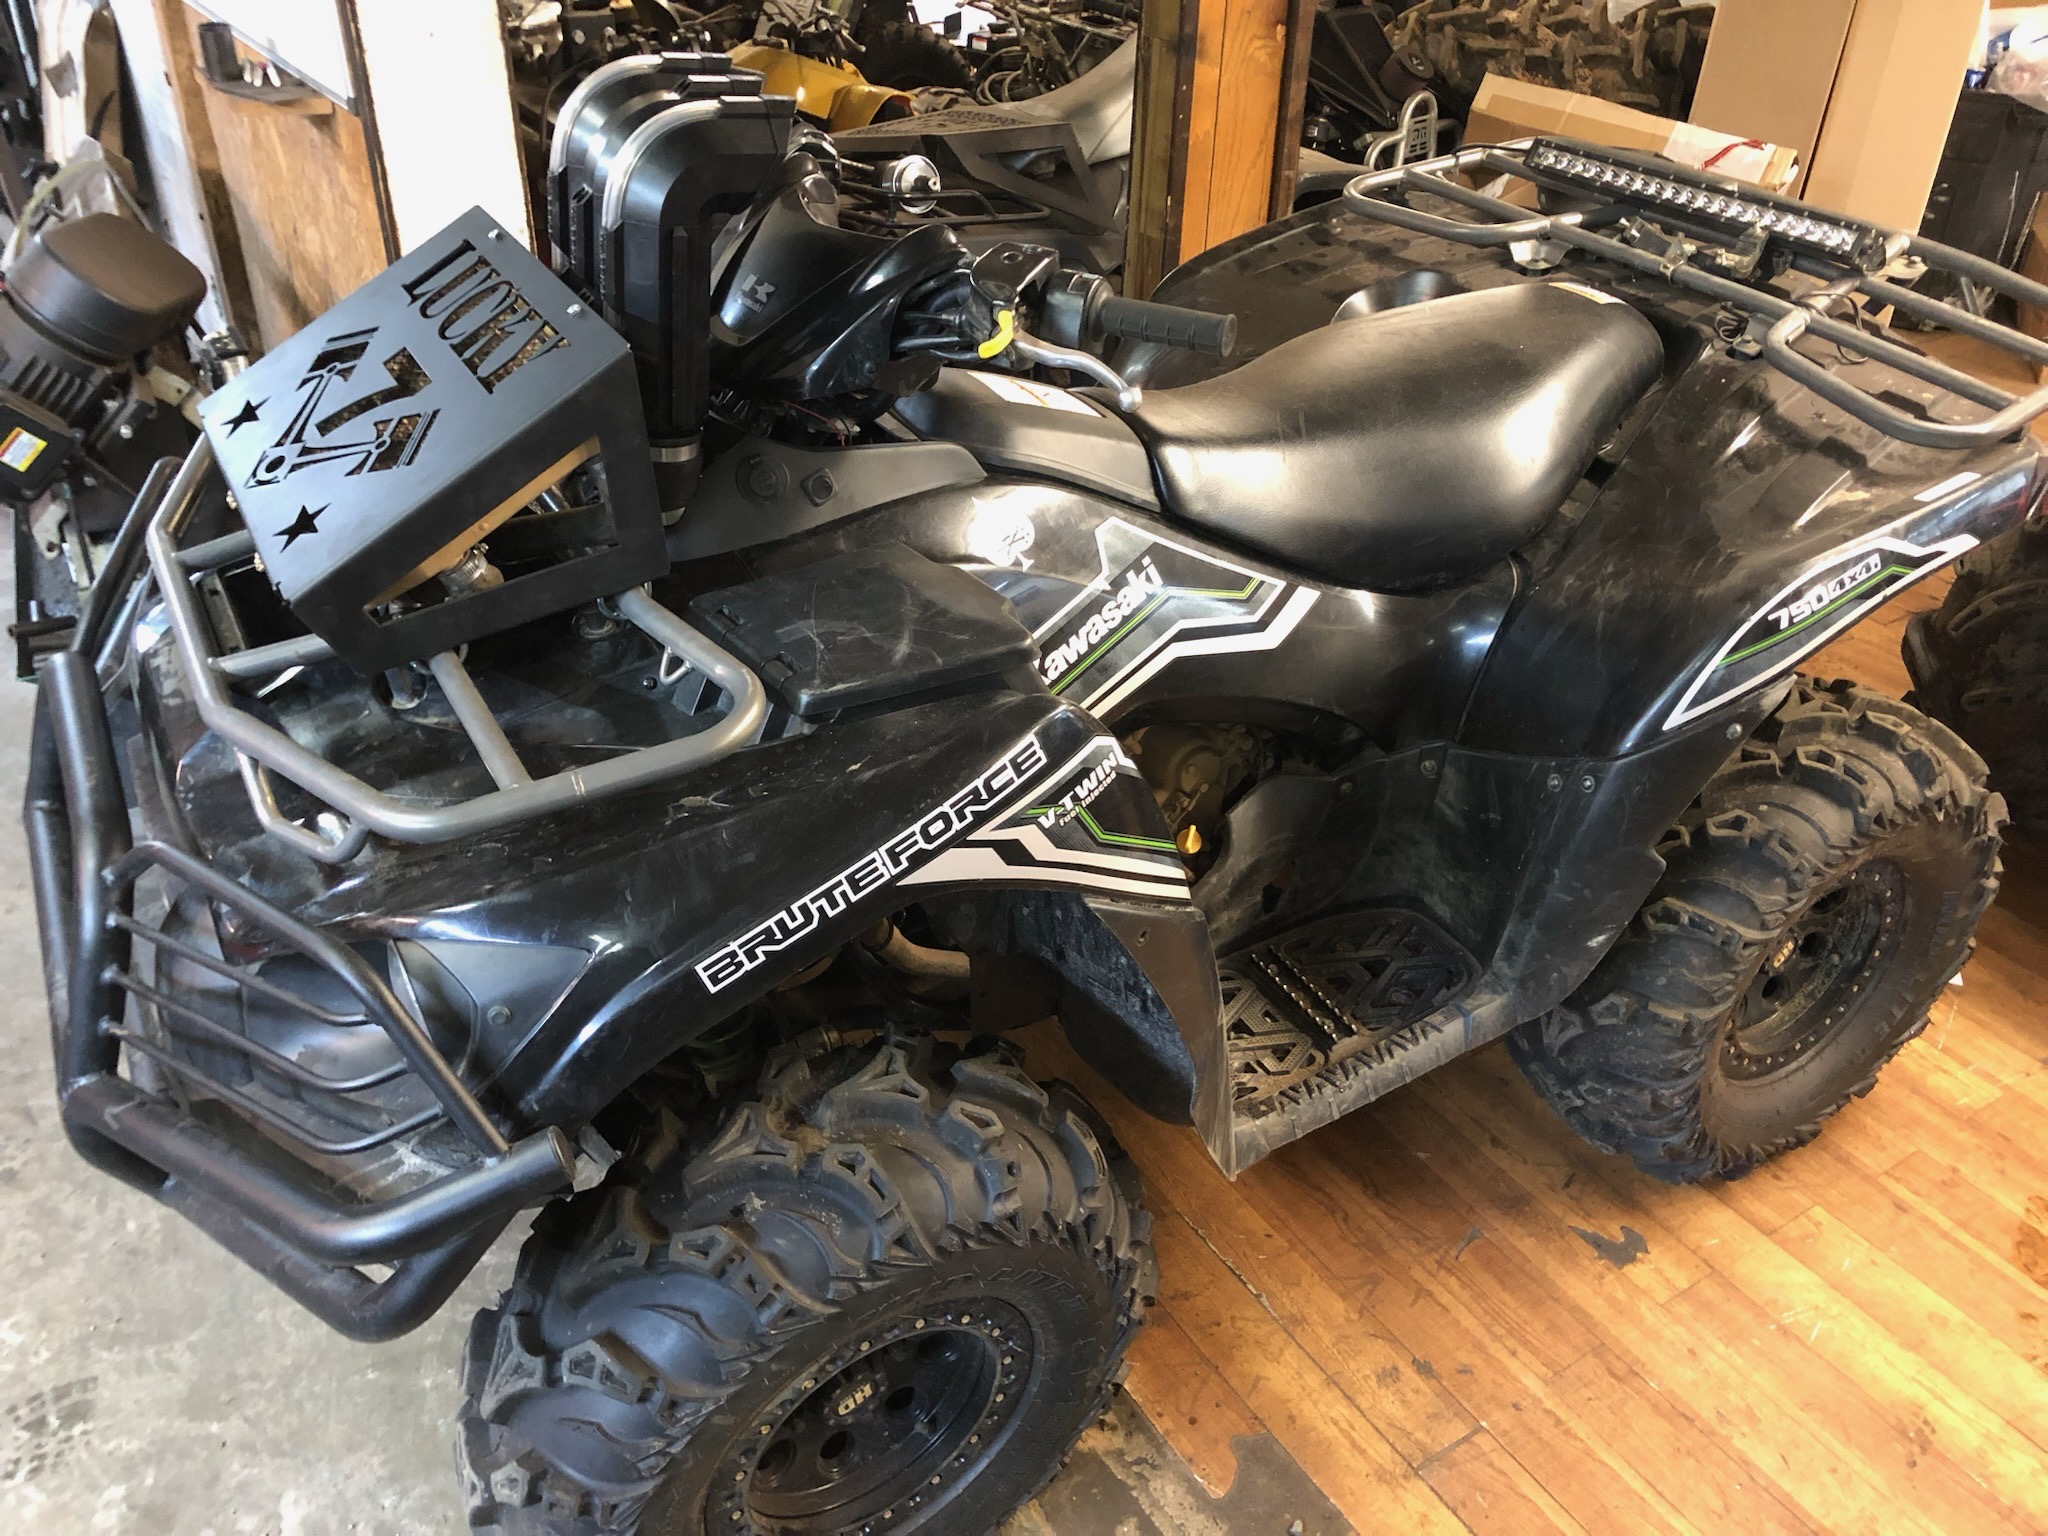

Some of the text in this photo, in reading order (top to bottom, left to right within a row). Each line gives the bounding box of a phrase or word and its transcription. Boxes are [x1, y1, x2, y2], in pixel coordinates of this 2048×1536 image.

[401, 239, 571, 395] LUCKY
[1767, 583, 1831, 631] 750
[1037, 751, 1118, 829] V-TWIN
[1059, 805, 1081, 827] Fuel
